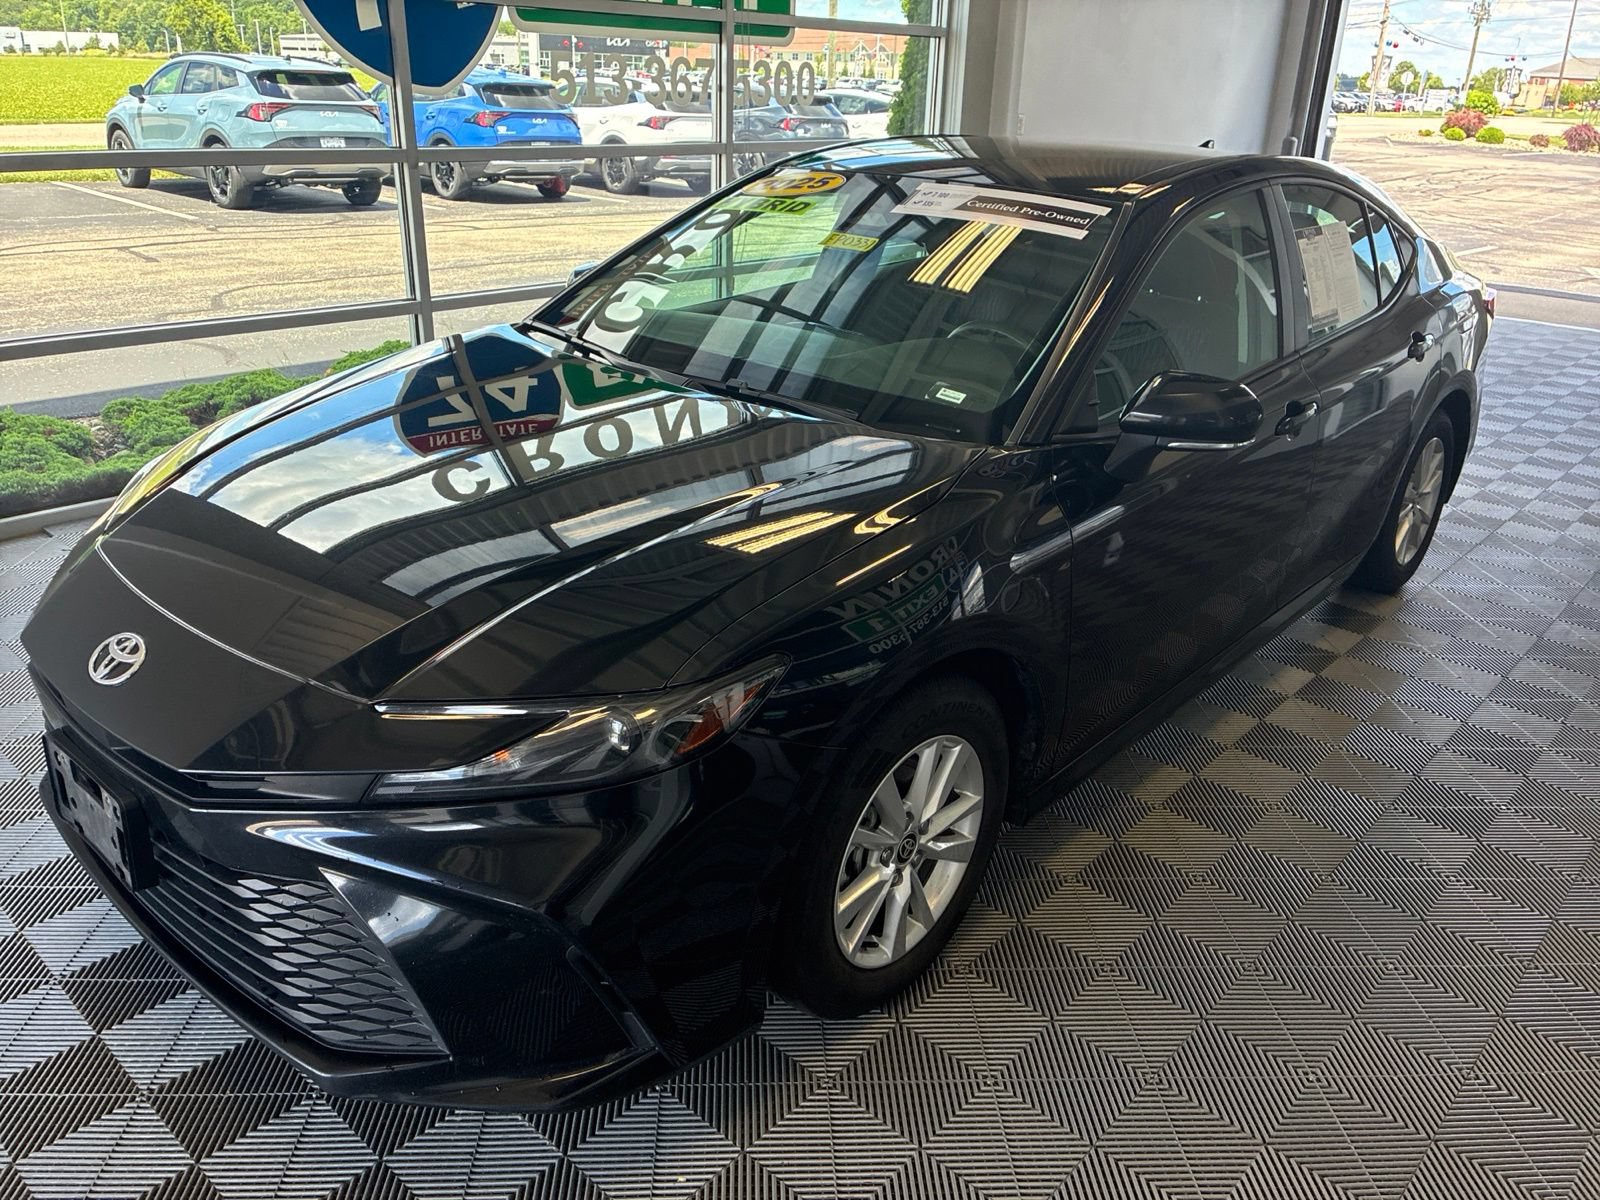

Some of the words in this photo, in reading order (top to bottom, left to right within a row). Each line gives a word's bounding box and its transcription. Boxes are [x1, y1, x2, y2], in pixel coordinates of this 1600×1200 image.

[762, 175, 838, 192] 2025
[966, 199, 1018, 213] Certified
[1019, 206, 1090, 226] Pre-Owned
